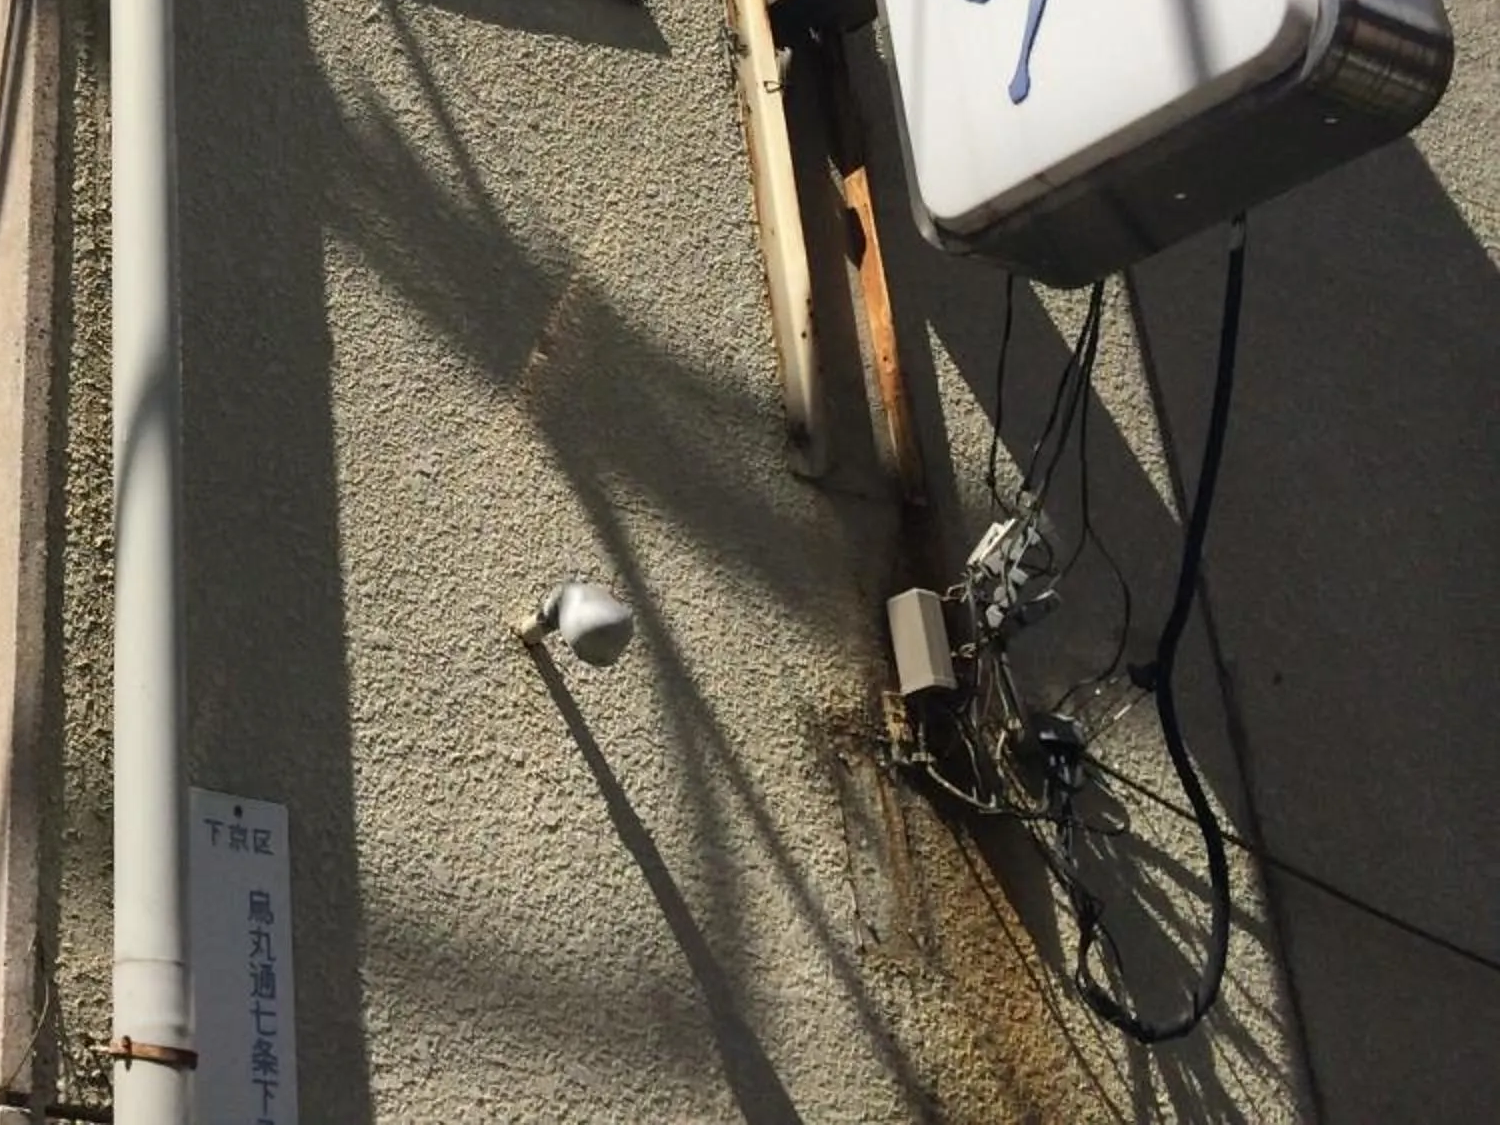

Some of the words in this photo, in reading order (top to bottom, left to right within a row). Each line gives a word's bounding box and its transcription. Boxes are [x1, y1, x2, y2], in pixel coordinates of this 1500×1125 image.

[203, 818, 275, 856] 下京区
[247, 889, 280, 1125] 烏丸通七条下
